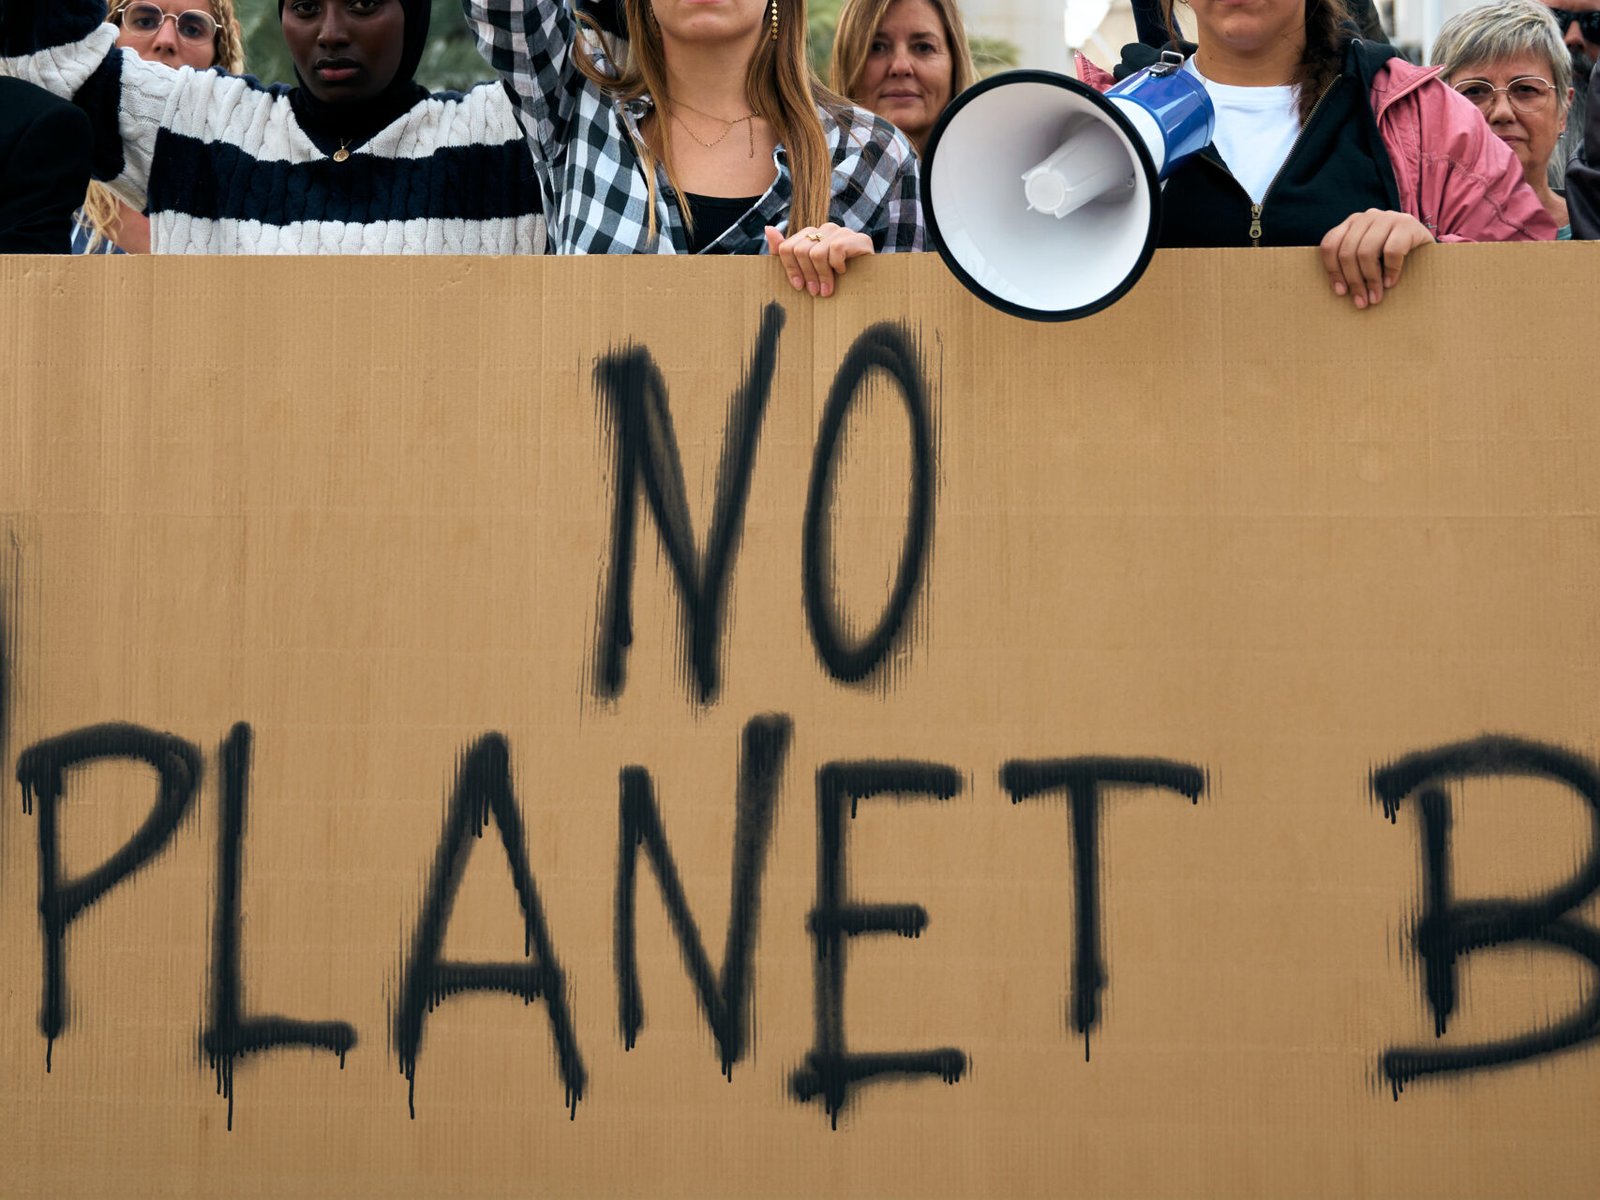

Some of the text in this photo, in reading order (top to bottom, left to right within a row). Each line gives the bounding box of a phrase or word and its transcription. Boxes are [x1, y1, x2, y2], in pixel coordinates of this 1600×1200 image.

[585, 302, 938, 705] NO
[16, 712, 1600, 1130] PLANET B
